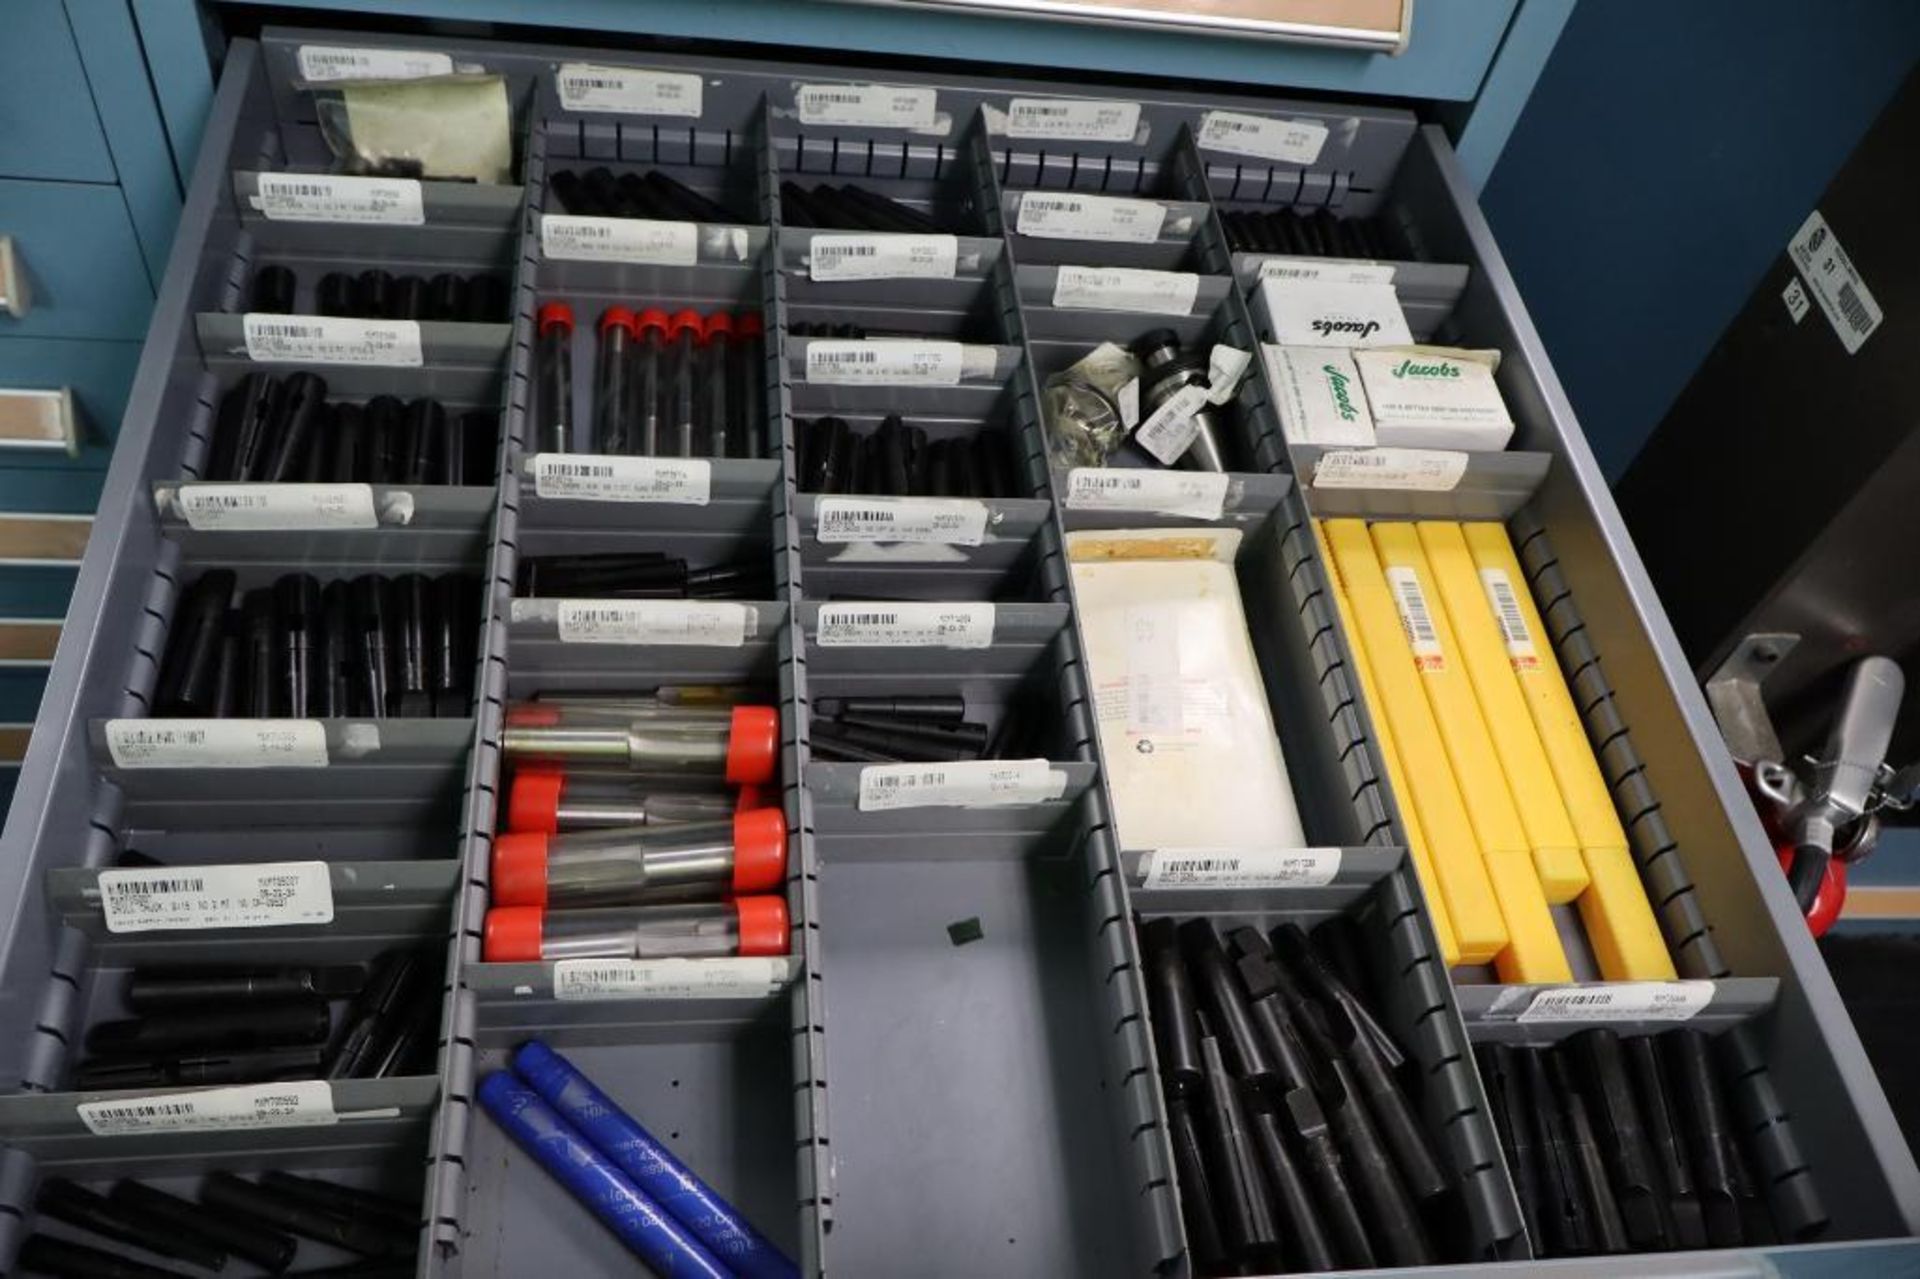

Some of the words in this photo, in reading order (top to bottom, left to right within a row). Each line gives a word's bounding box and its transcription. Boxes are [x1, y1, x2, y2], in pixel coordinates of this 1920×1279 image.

[1823, 258, 1836, 275] 31
[1788, 289, 1804, 312] 31
[1312, 319, 1380, 338] Jacobs
[1392, 360, 1461, 379] Jacobs
[1324, 363, 1359, 422] Jacobs
